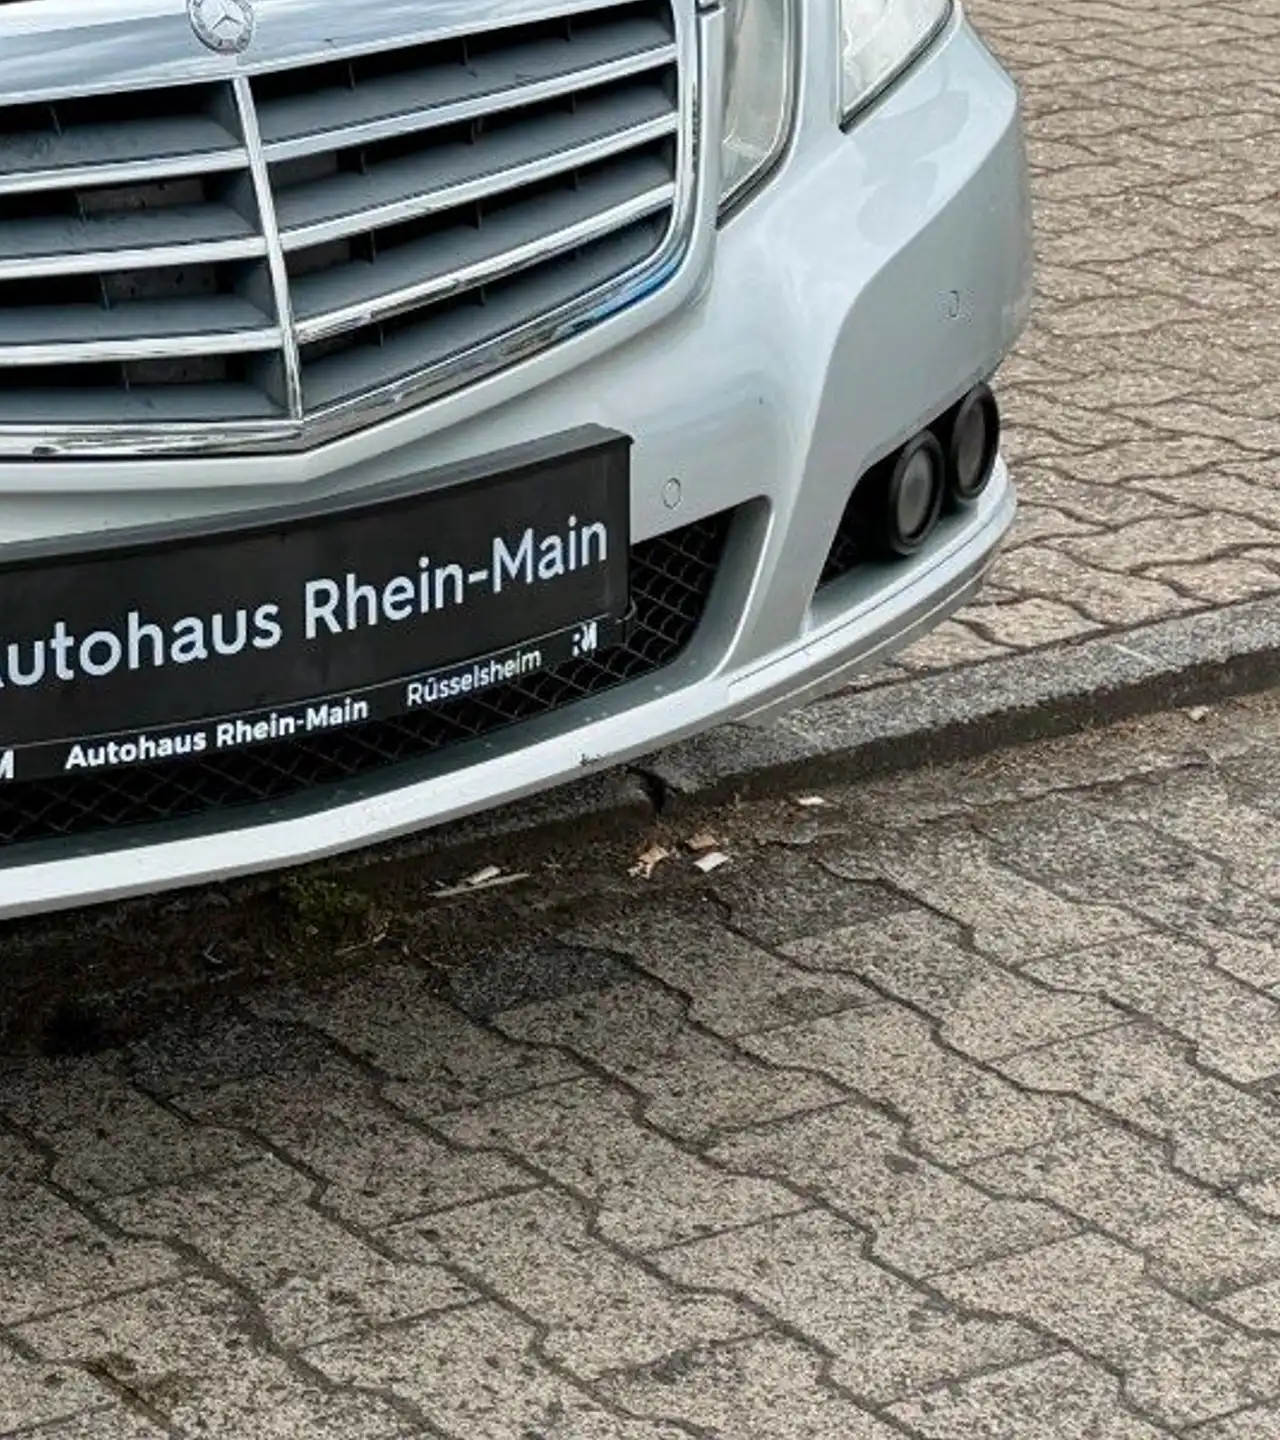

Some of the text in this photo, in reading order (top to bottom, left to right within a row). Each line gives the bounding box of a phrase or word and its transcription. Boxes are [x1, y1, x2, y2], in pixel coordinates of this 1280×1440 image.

[304, 515, 608, 640] Rhein-Main
[64, 648, 542, 770] Autohaus Rhein-Main Rüsselsheim
